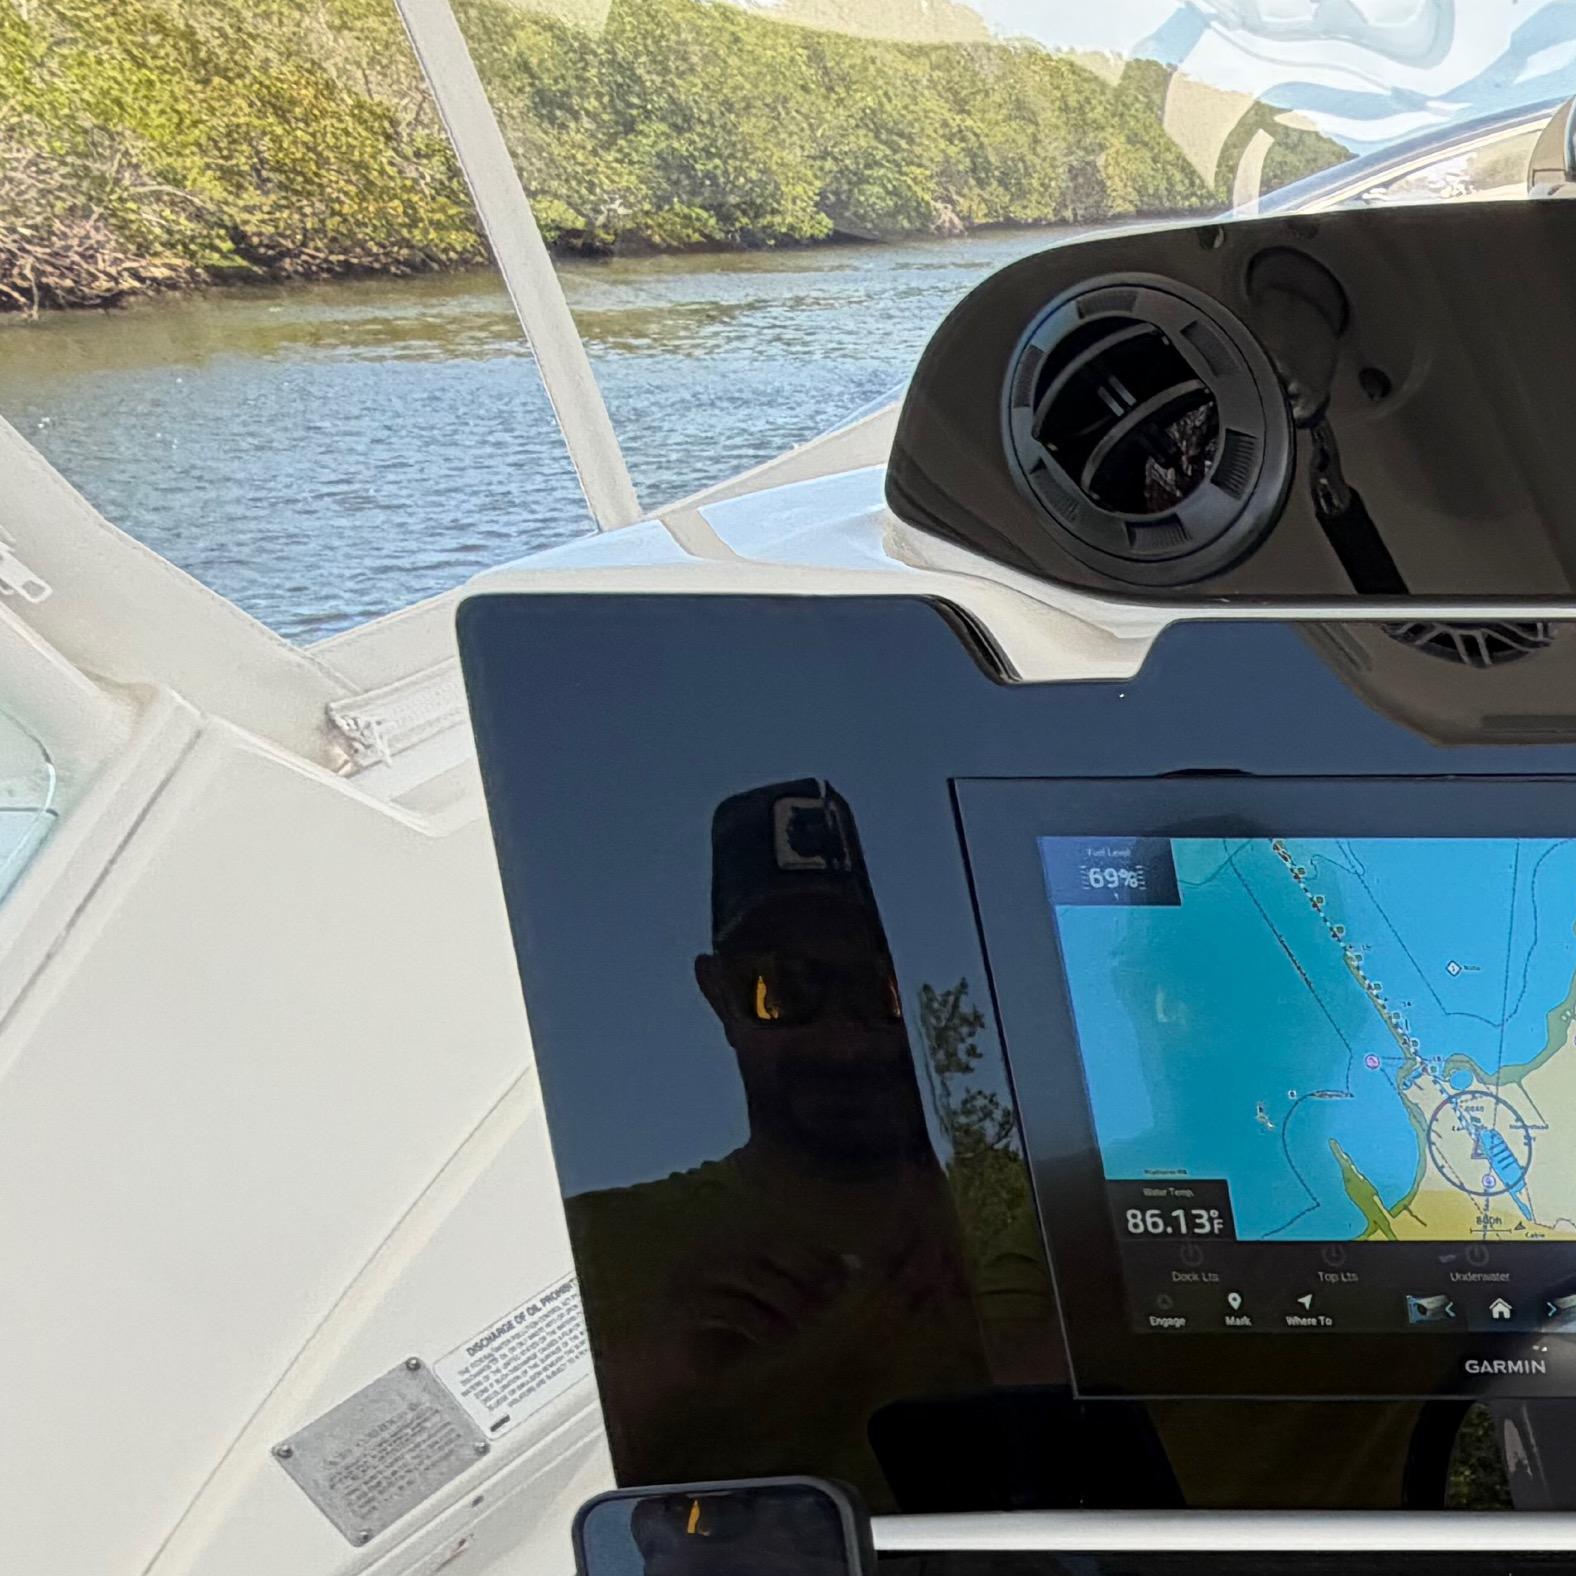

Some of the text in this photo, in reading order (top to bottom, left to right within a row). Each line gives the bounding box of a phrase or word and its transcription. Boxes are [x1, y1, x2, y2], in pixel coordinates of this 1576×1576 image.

[1089, 868, 1139, 888] 69%
[1172, 1271, 1220, 1282] Dock Lts
[1318, 1271, 1359, 1283] Top Lts
[1450, 1272, 1511, 1282] Underwater
[1150, 1316, 1186, 1328] Engage
[1225, 1316, 1252, 1326] Mark
[1286, 1316, 1333, 1326] Where To
[466, 1320, 516, 1357] DISCHARGE
[514, 1311, 527, 1325] OF
[526, 1303, 542, 1316] OIL
[1465, 1359, 1546, 1374] GARMIN
